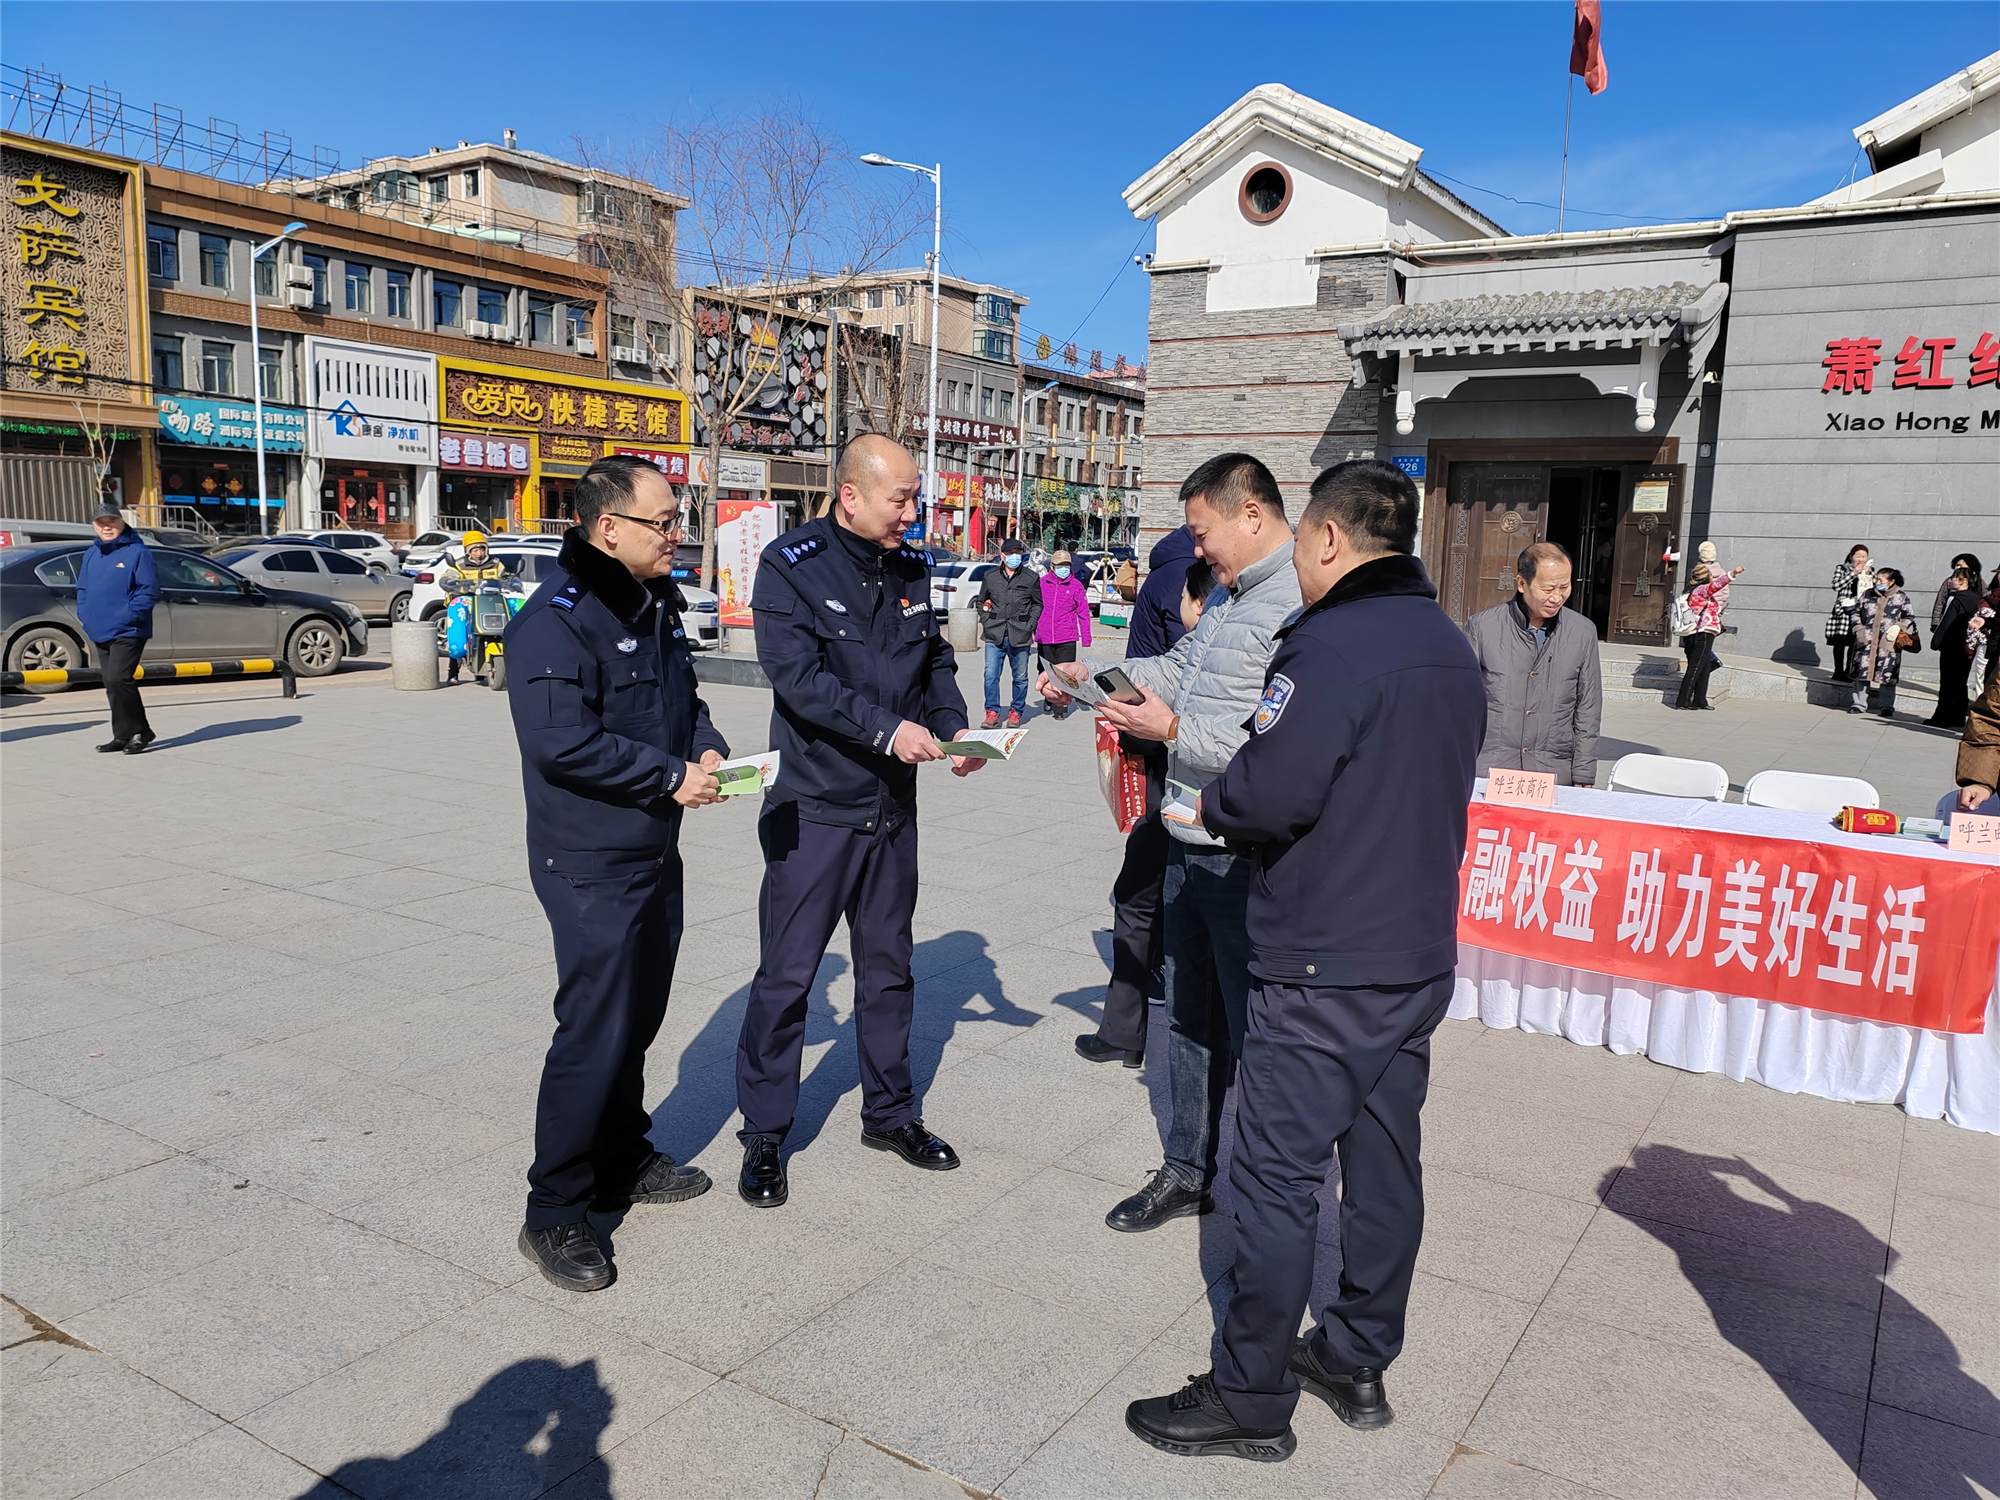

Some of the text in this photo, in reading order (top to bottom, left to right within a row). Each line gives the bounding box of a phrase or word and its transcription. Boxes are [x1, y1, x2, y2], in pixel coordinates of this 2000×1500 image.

[1825, 412, 1885, 432] Xiao
[1895, 411, 1970, 434] Hong
[439, 436, 528, 470] 老鲁饭包
[1399, 463, 1418, 471] 226
[1494, 775, 1549, 799] 呼兰农商行
[1462, 827, 1926, 996] 融权益 助力美好生活
